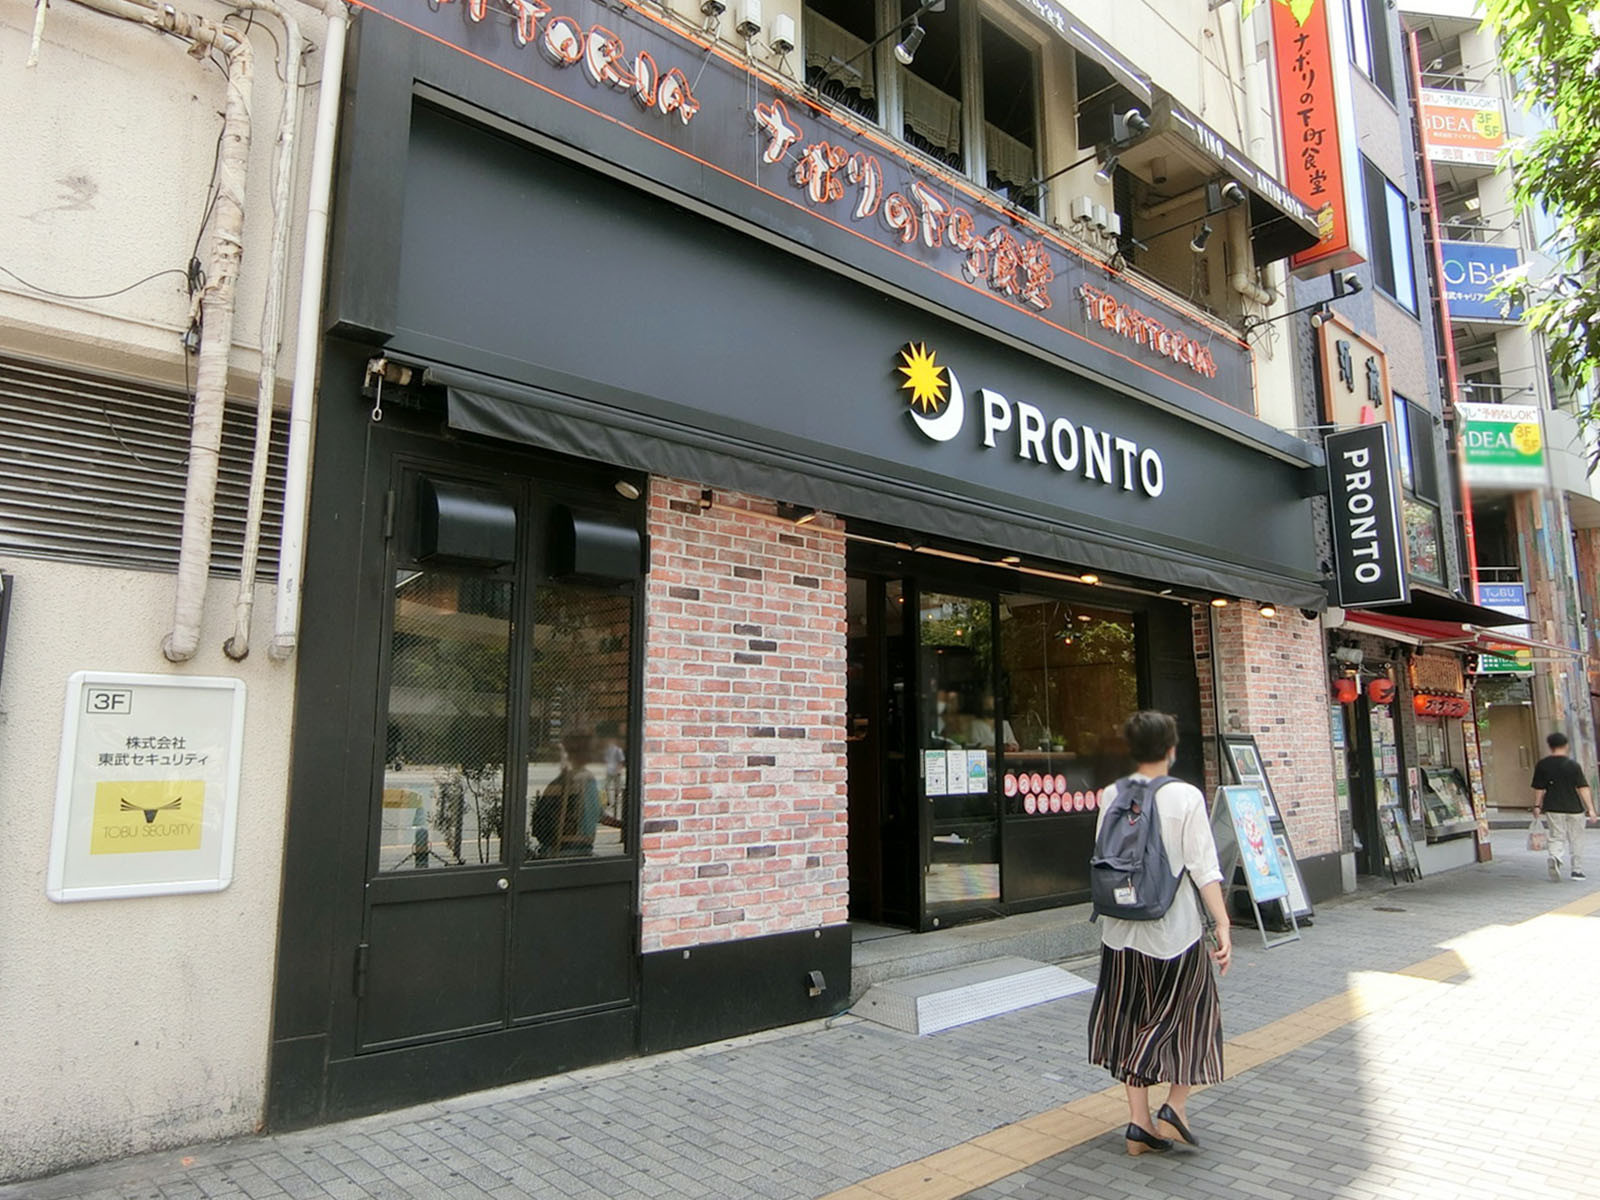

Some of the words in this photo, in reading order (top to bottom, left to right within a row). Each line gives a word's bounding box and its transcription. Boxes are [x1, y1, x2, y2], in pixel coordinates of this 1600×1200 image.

[1292, 33, 1328, 197] ナポリの下町食堂
[1477, 112, 1493, 125] 3F
[1485, 126, 1499, 137] 5F
[1079, 281, 1218, 378] TRATTORIA
[1515, 425, 1531, 438] 3F
[980, 387, 1165, 499] PRONTO
[1343, 447, 1382, 585] PRONTO
[94, 693, 125, 710] 3F
[126, 736, 187, 750] 株式会社
[98, 752, 209, 767] 東武セキュリティ
[104, 825, 139, 839] TOBU
[142, 823, 194, 838] SECURITY
